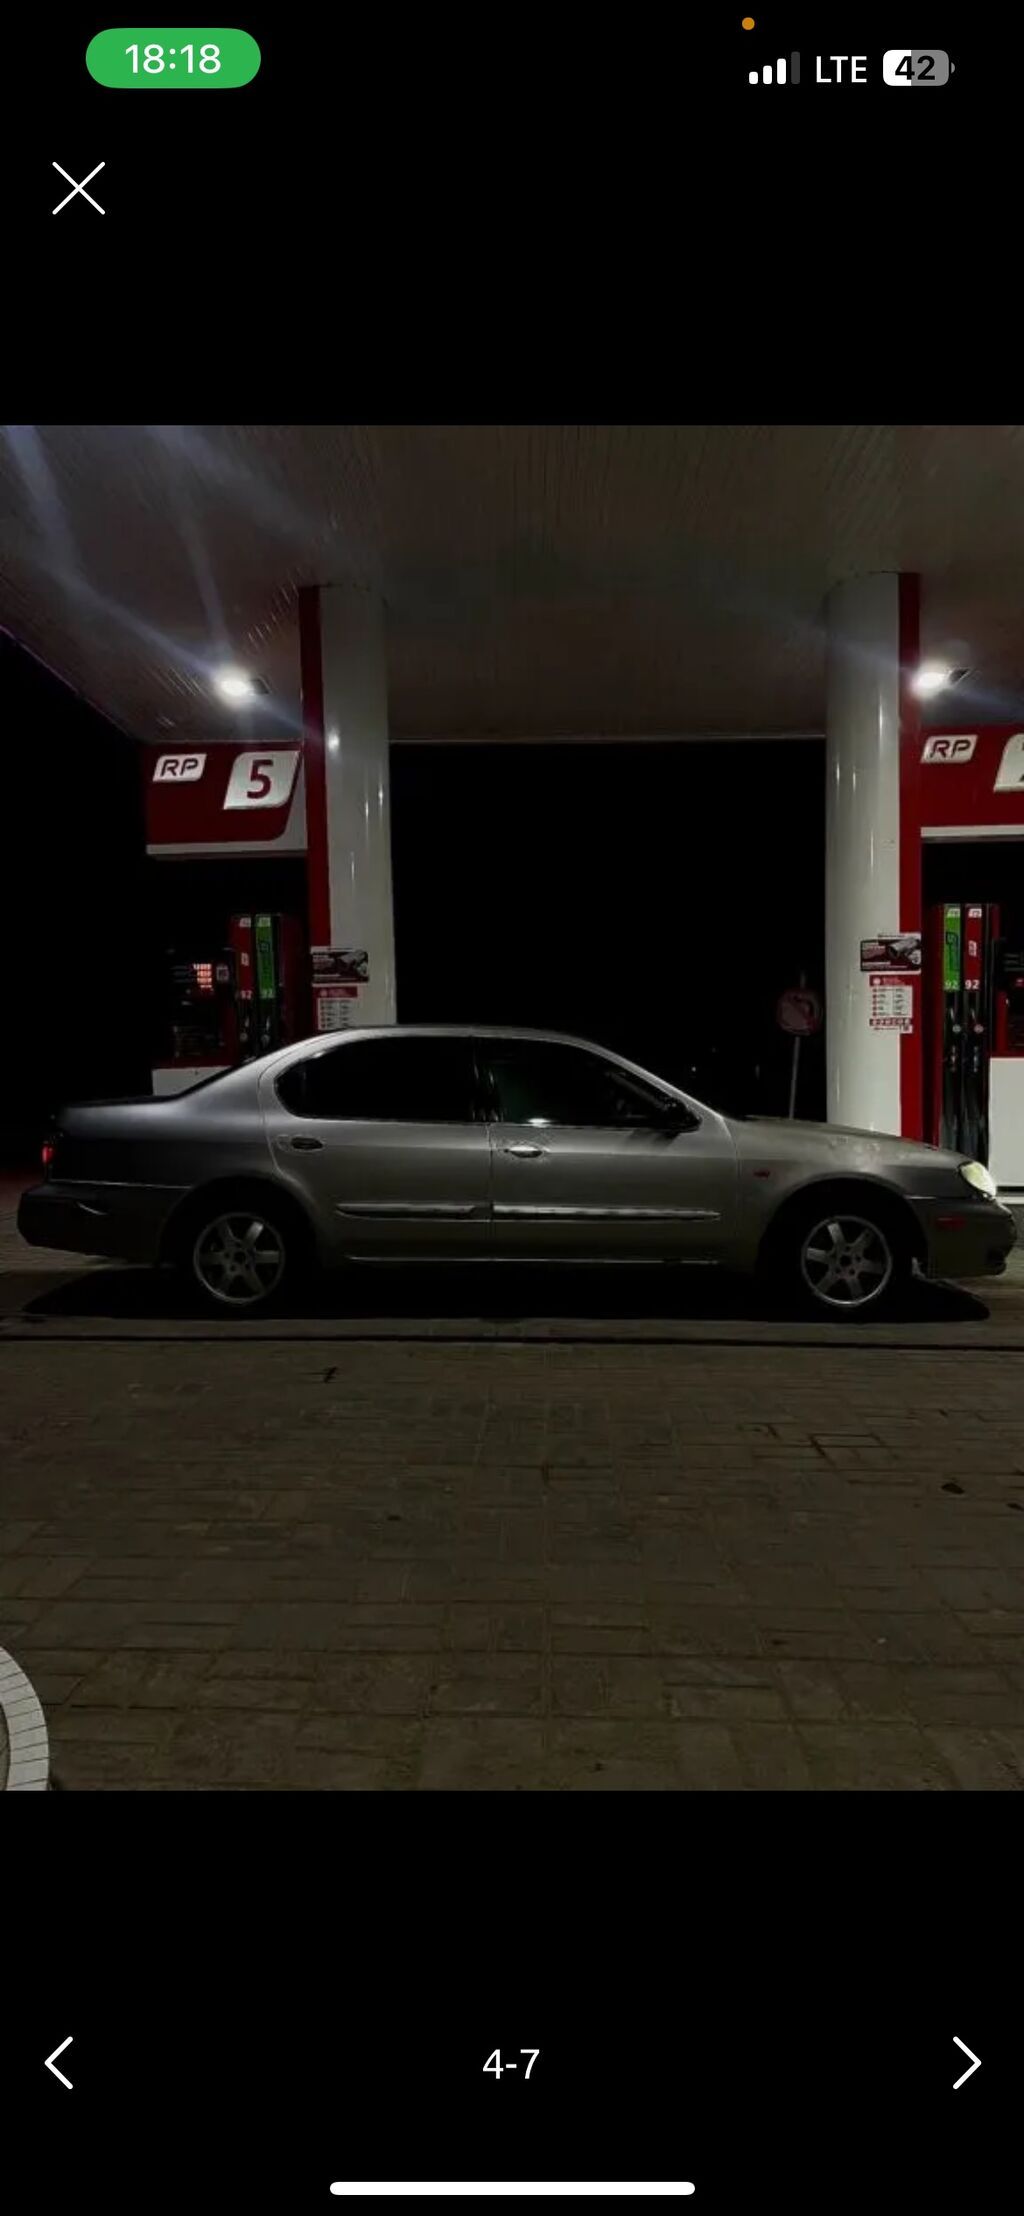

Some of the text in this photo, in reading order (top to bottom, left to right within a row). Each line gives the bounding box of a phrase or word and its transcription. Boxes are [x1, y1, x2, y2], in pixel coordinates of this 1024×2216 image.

[929, 740, 971, 759] RP
[160, 758, 198, 777] RP
[247, 759, 273, 799] 5
[965, 979, 980, 990] 92
